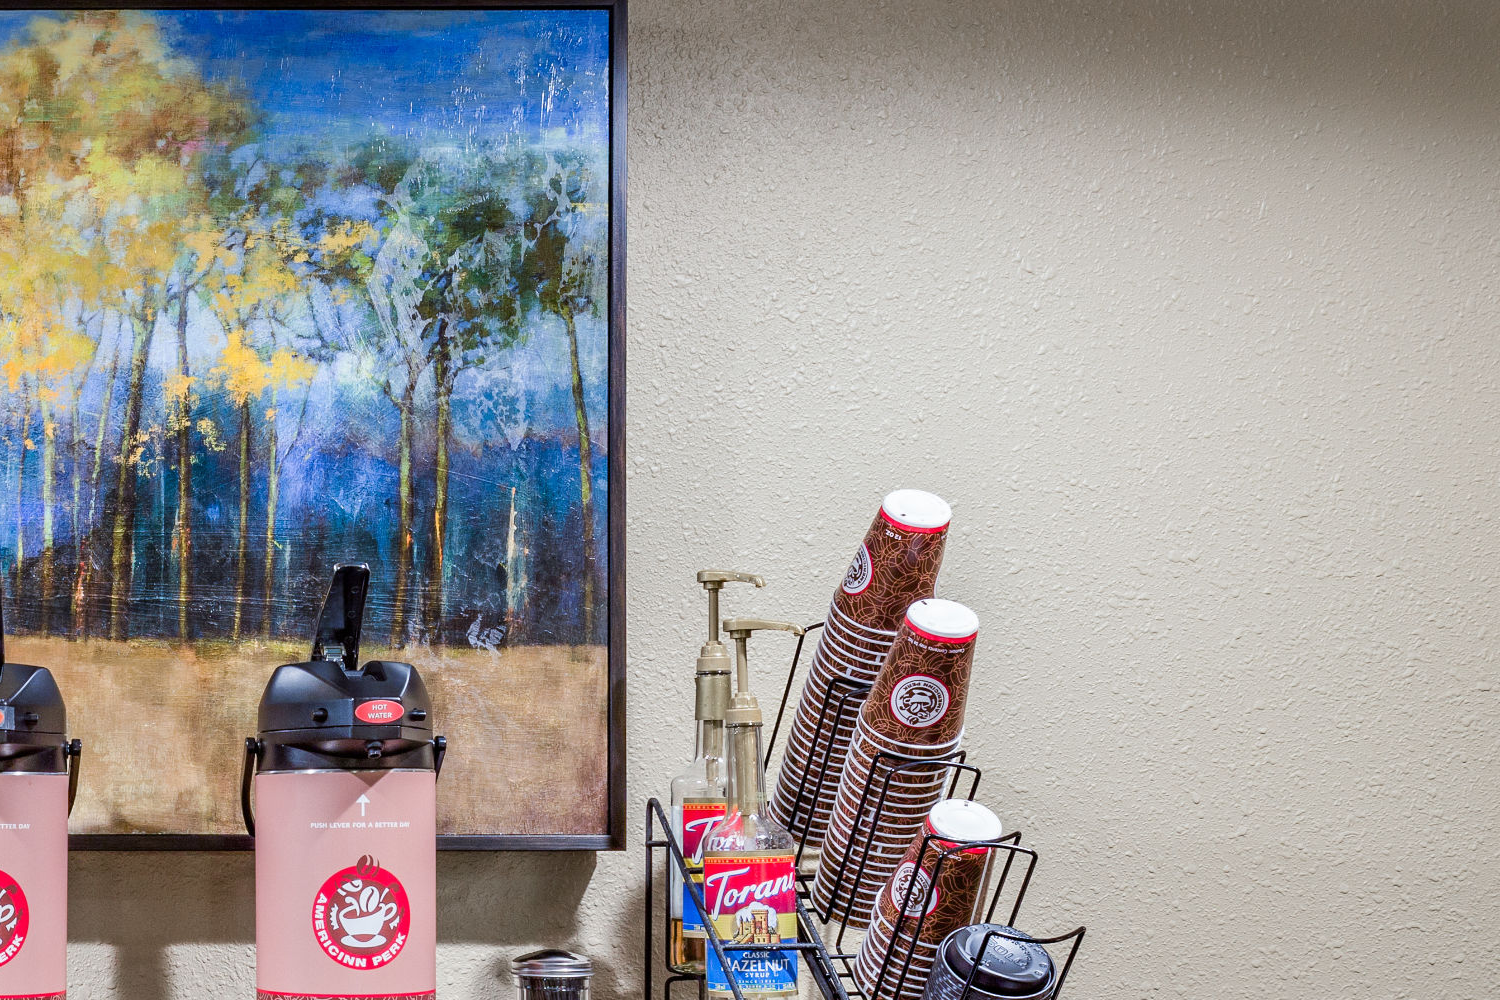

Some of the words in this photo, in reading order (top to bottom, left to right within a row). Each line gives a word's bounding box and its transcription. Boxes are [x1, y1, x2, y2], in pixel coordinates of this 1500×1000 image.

[707, 862, 795, 921] Torani
[313, 892, 367, 968] AMERICINN
[372, 932, 407, 967] PERK
